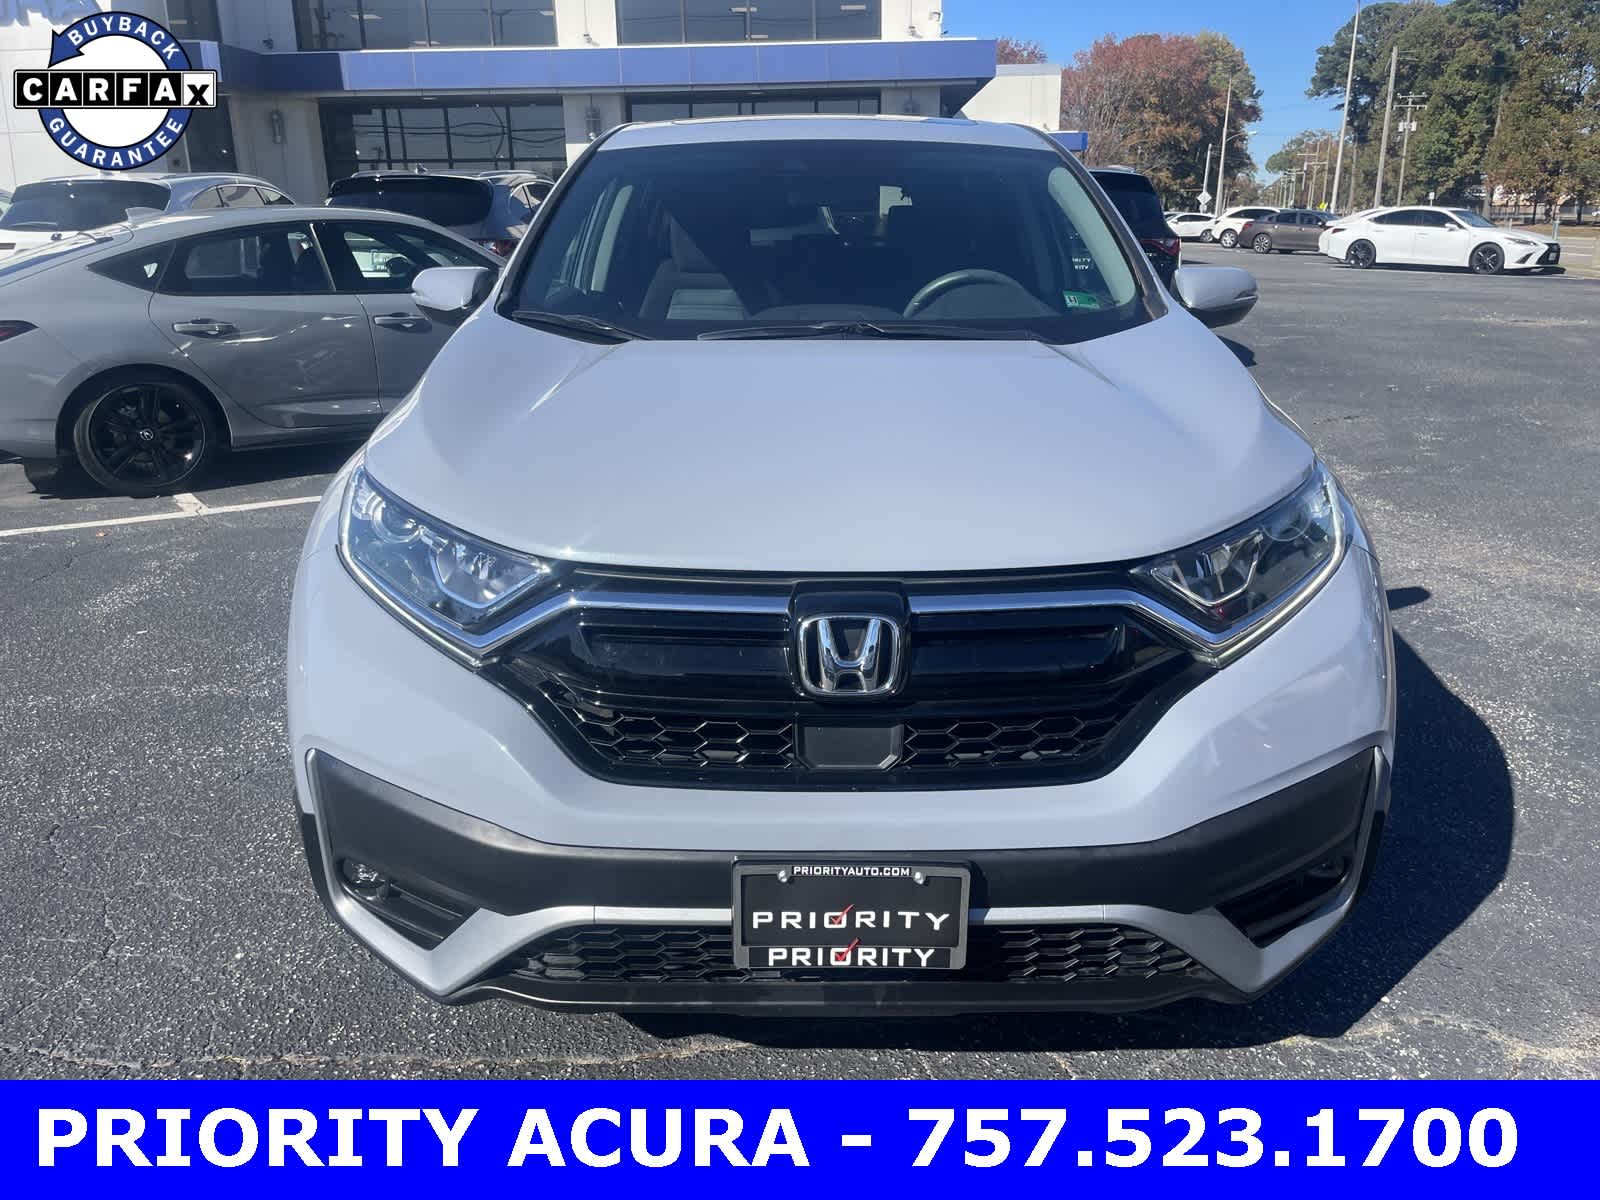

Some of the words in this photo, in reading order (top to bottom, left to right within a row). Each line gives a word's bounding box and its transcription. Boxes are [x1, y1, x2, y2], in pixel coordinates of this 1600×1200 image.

[793, 866, 910, 877] PRIORITYAUTO.COM
[752, 910, 950, 931] PRIORITY
[768, 947, 935, 967] PRIORITY
